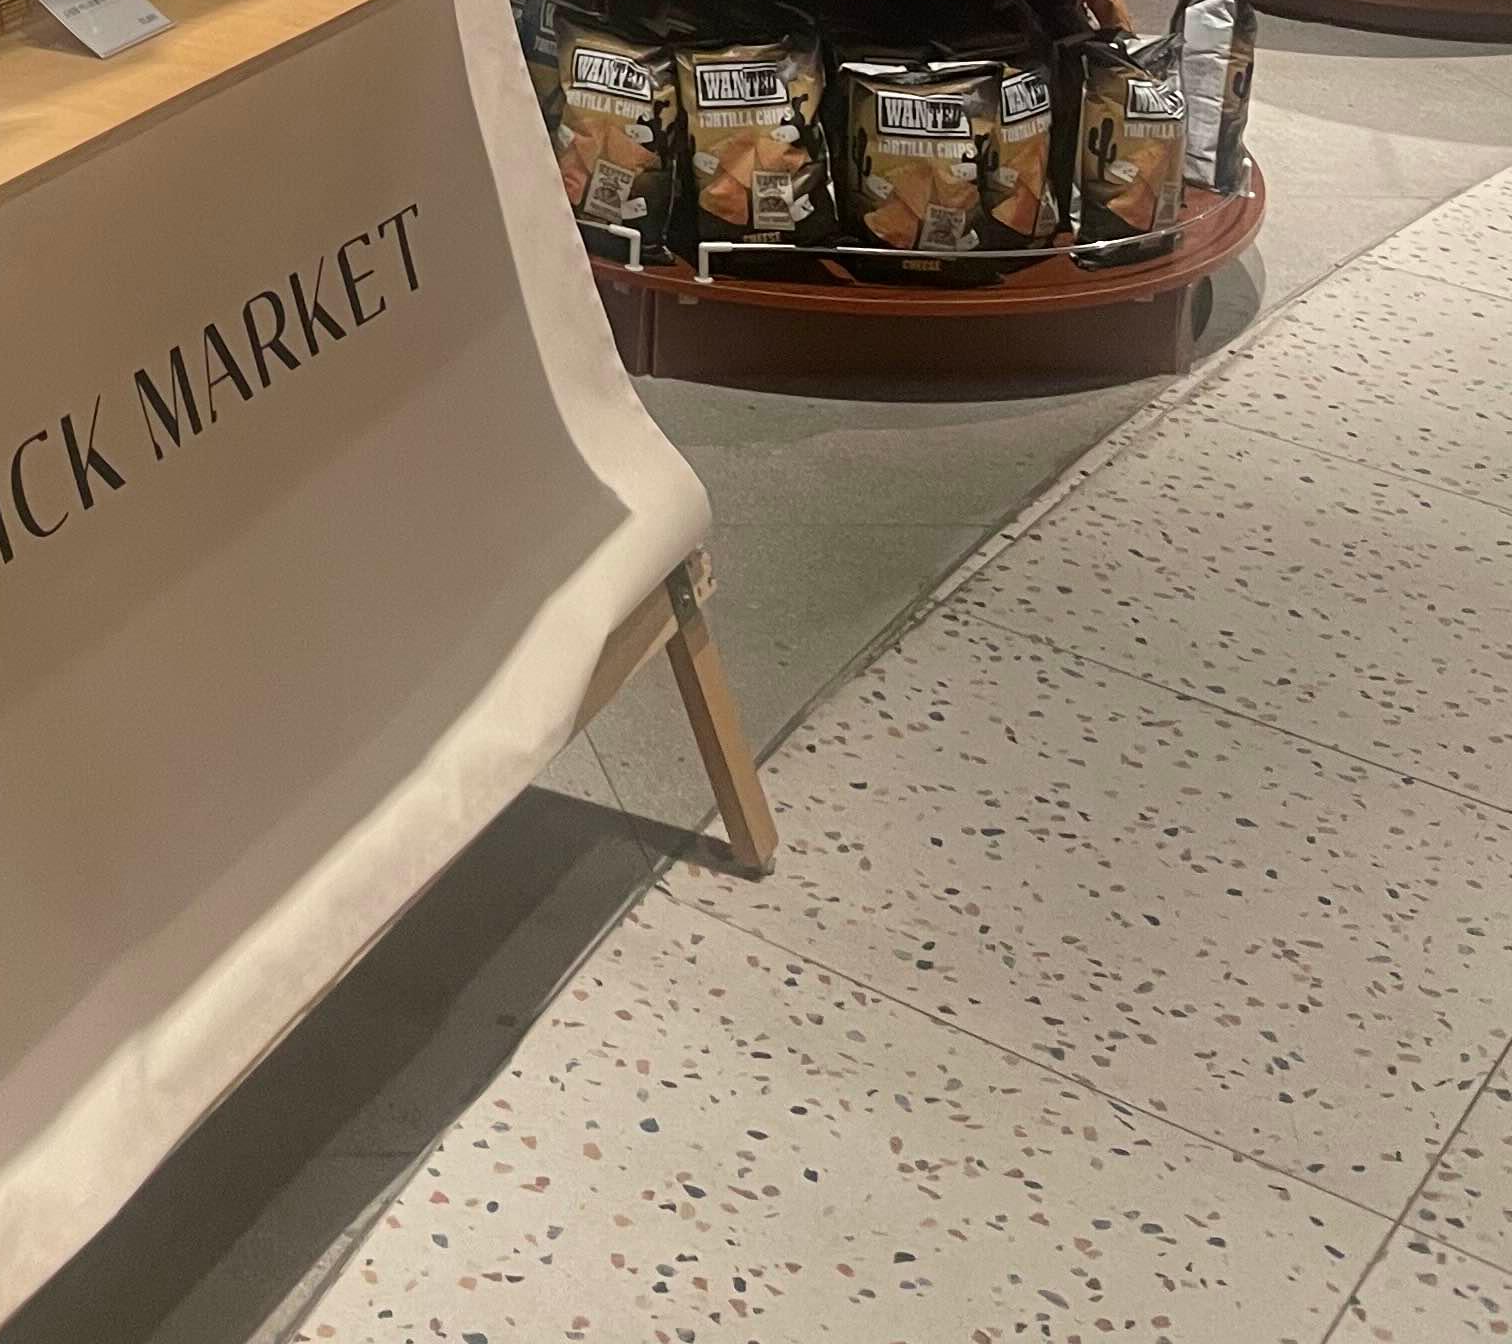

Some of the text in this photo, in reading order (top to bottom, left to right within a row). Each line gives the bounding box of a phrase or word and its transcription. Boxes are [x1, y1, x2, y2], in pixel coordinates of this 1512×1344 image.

[575, 53, 646, 93] WANTED
[702, 69, 777, 100] WANTED
[698, 106, 793, 129] TORTILLA CHIPS
[878, 140, 977, 159] TORTILLA CHIPS
[133, 202, 420, 461] MARKET
